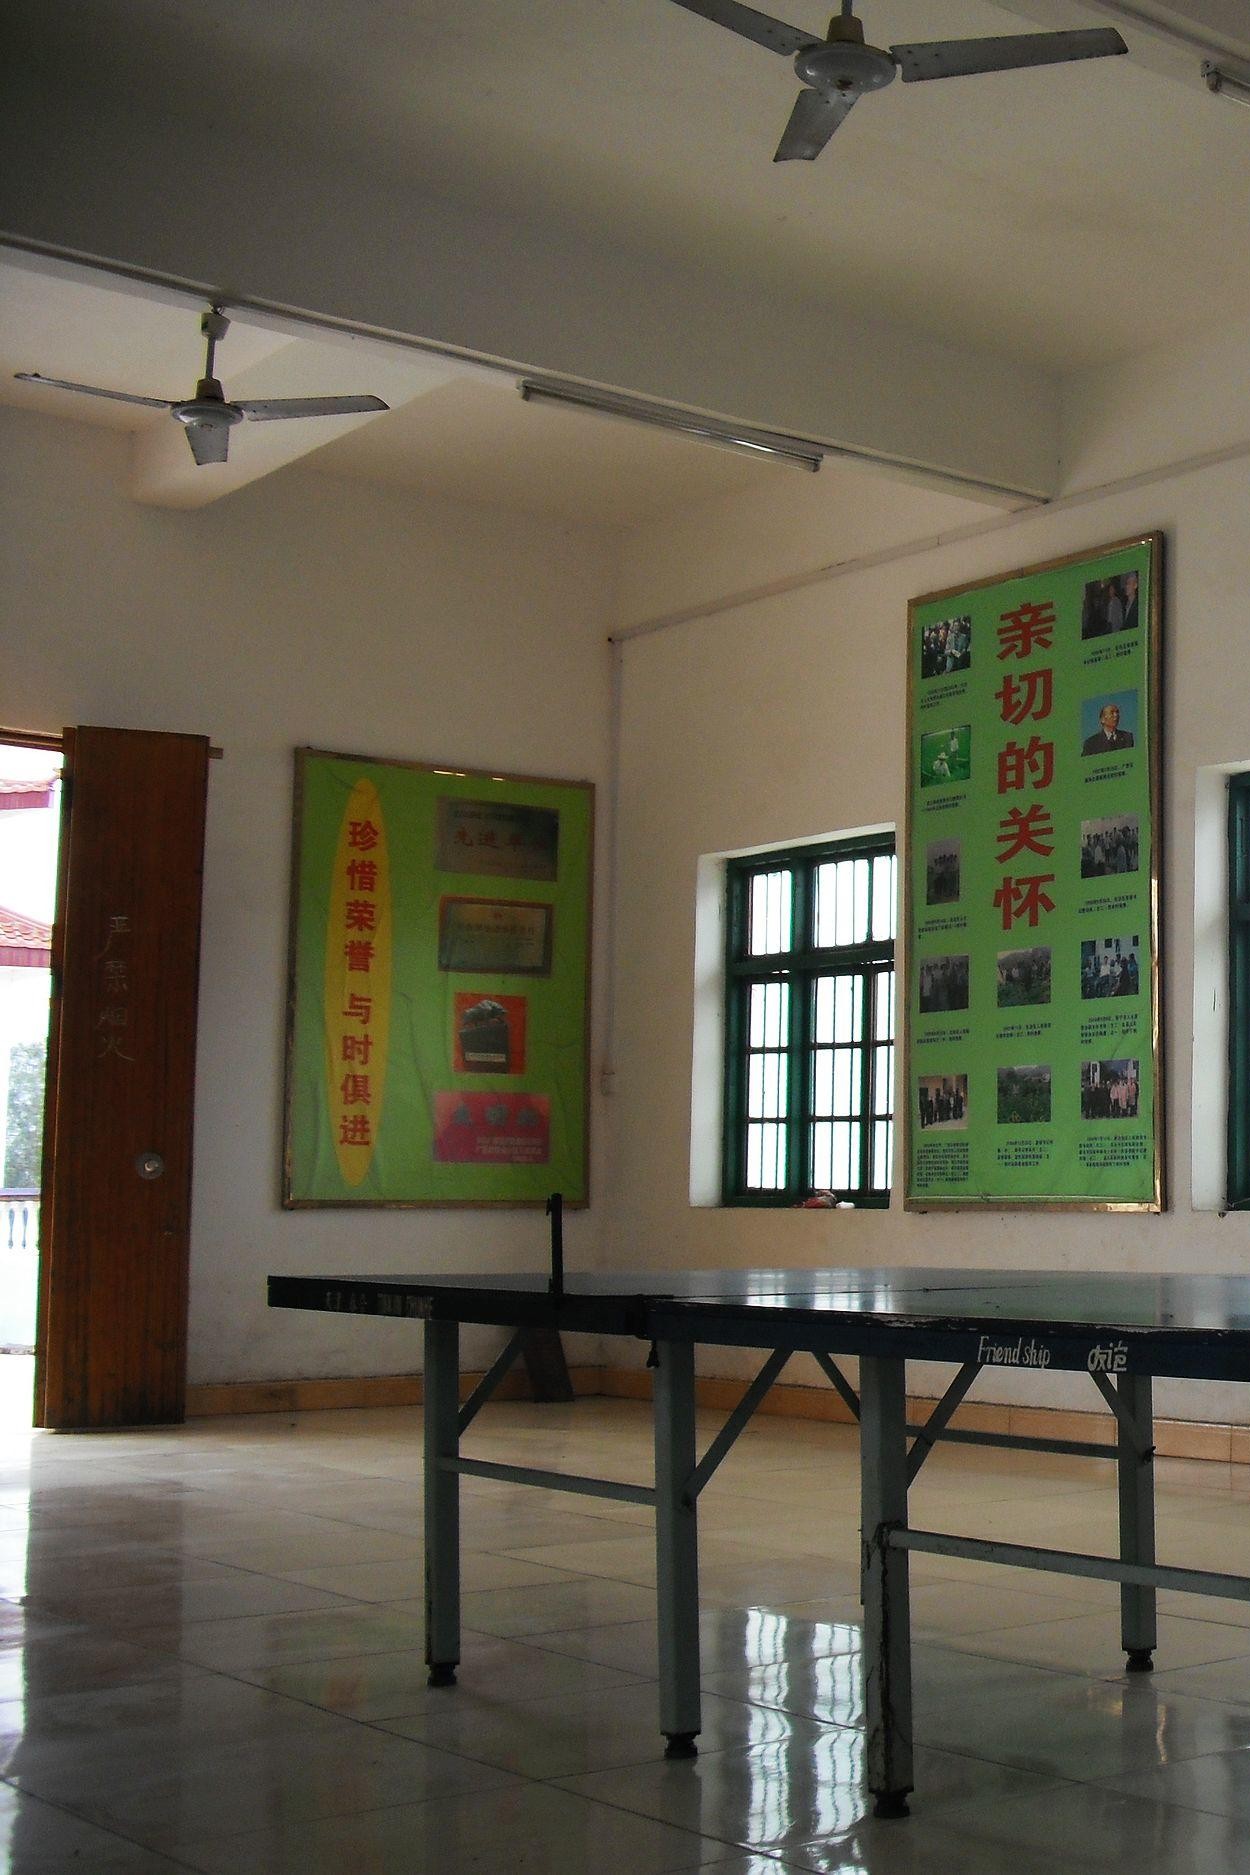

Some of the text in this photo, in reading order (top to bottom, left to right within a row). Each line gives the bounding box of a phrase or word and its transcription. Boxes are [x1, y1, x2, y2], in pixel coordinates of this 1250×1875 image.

[992, 601, 1057, 931] 亲切的关怀
[339, 819, 380, 1147] 珍惜荣誉 与时俱进
